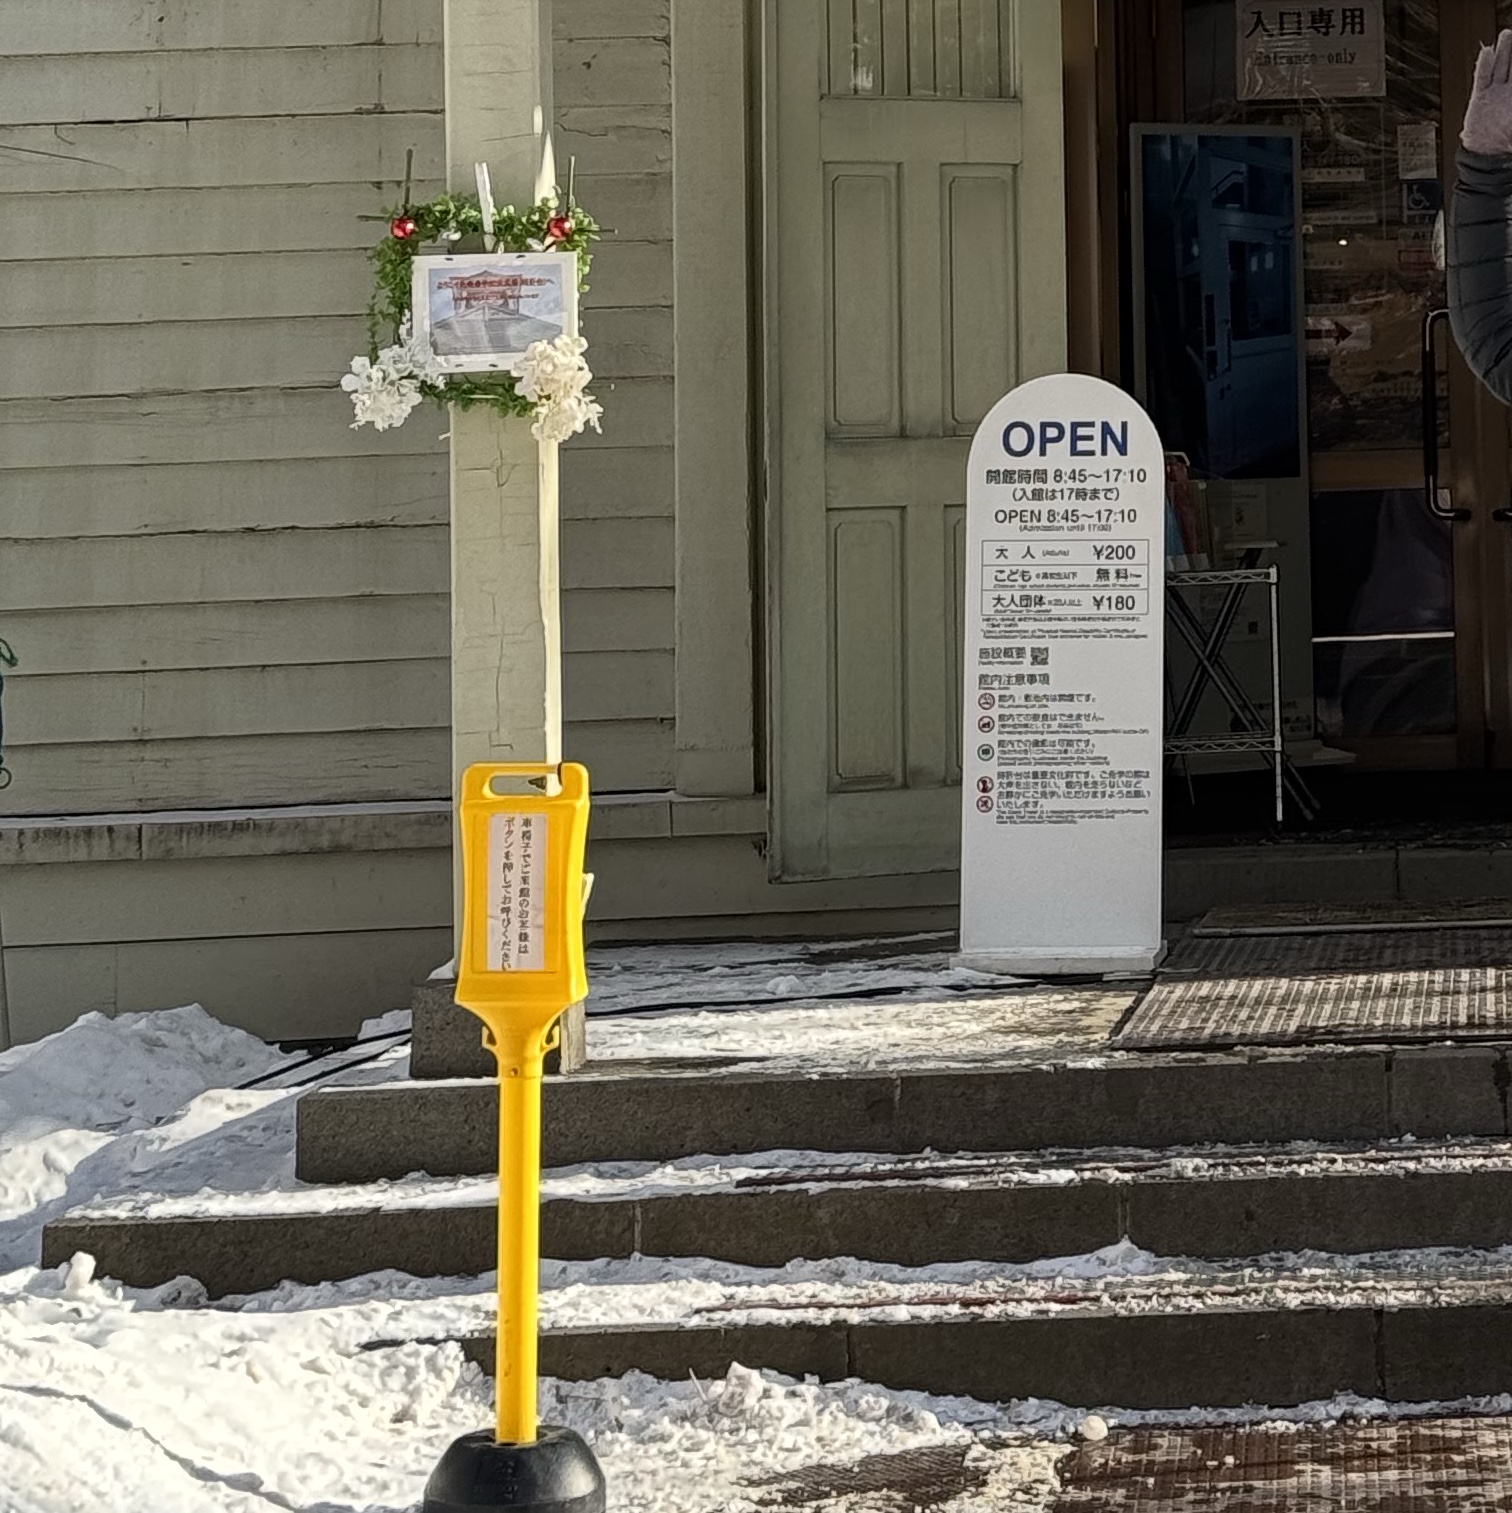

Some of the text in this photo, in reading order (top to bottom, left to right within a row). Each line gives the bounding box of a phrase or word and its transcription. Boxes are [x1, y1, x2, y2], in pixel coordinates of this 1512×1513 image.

[1246, 7, 1365, 38] 入口専用
[1002, 421, 1129, 458] OPEN
[985, 469, 1048, 485] 開館時間
[994, 509, 1042, 524] OPEN
[1092, 544, 1136, 560] ¥200
[994, 569, 1032, 583] こども
[992, 594, 1046, 608] 大人団体
[1092, 595, 1136, 610] ¥180
